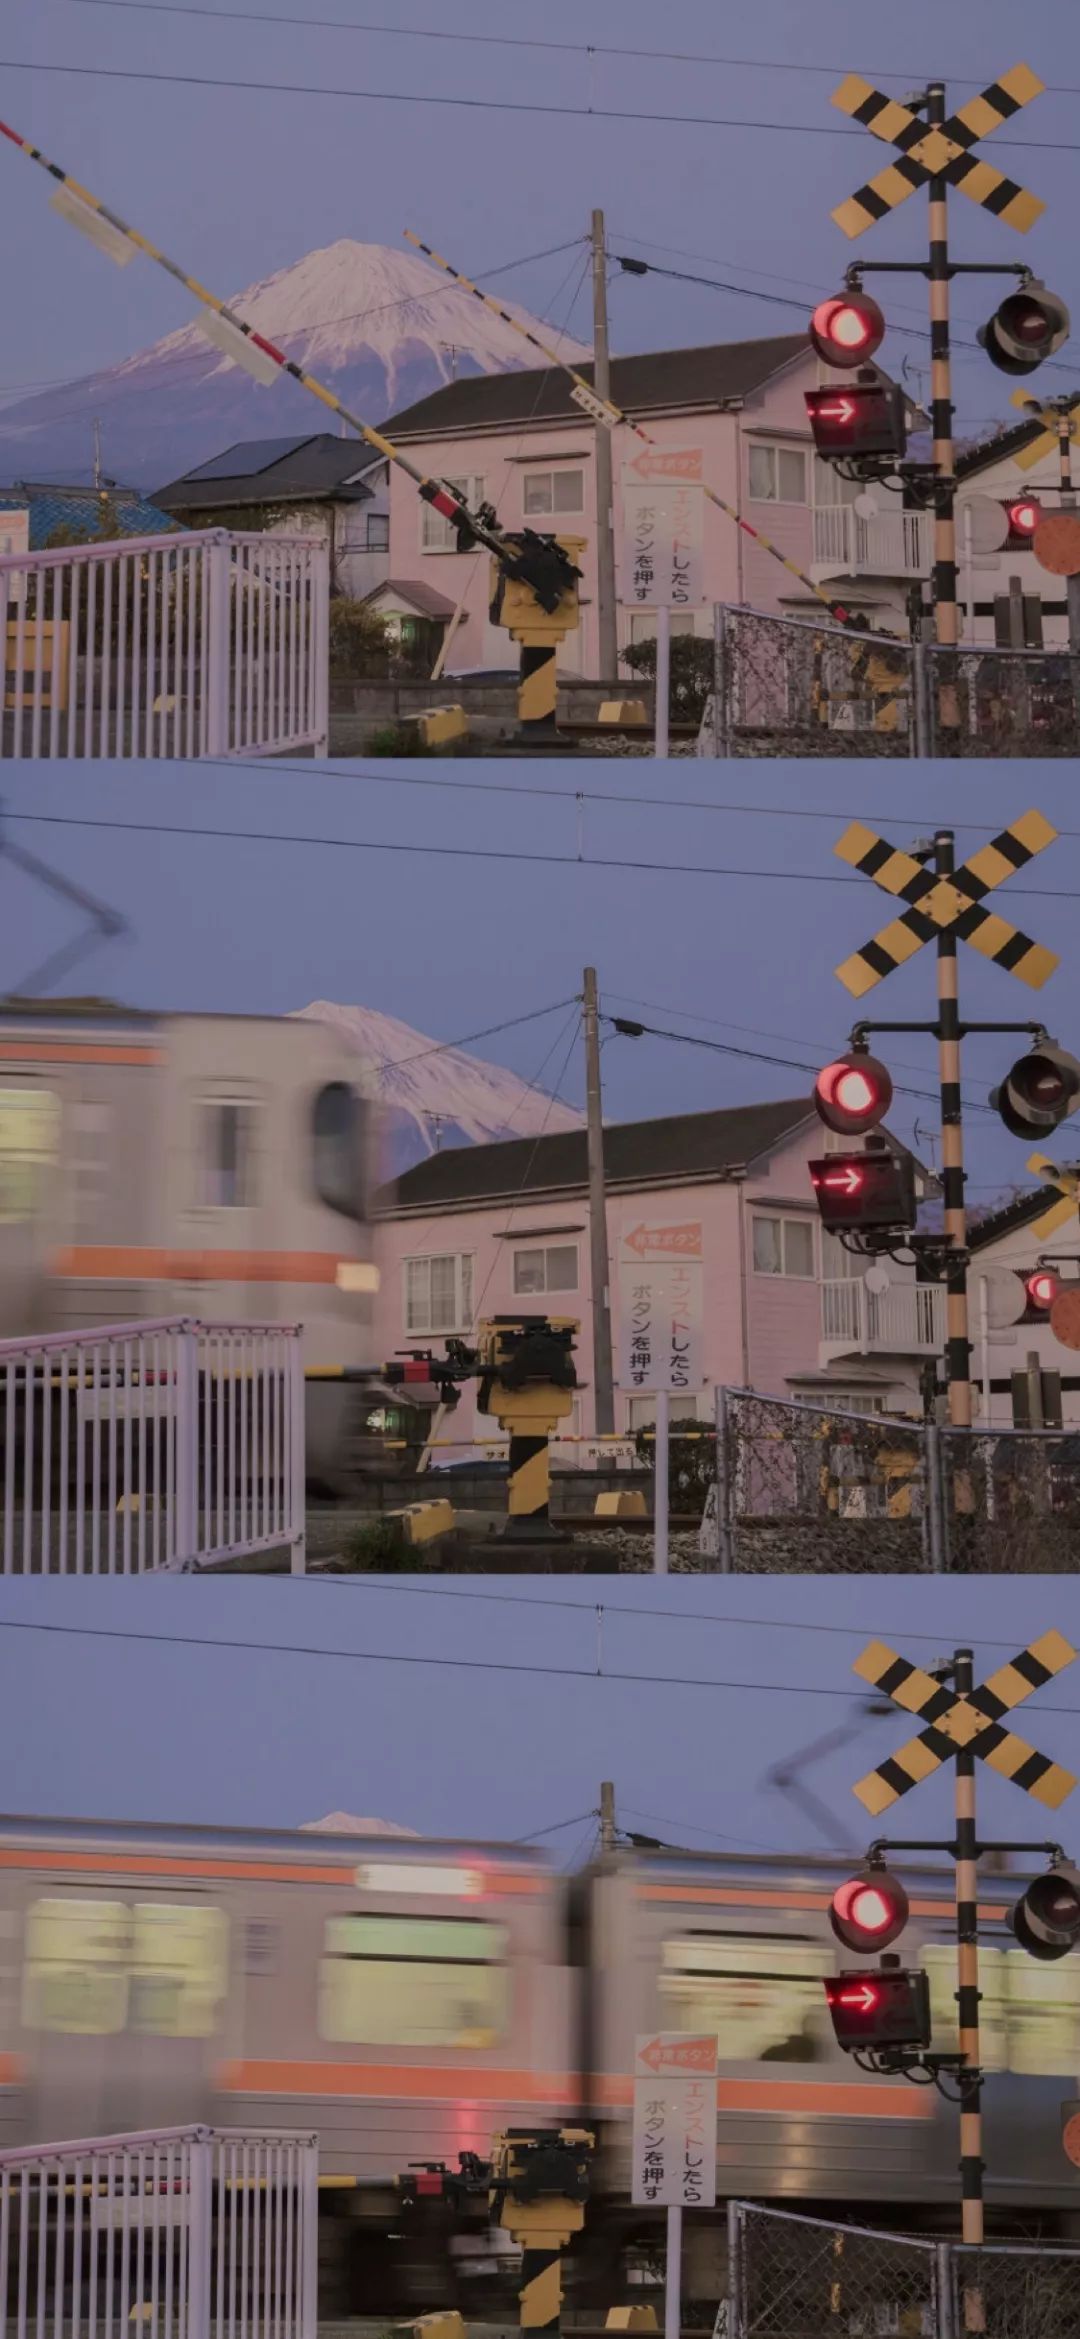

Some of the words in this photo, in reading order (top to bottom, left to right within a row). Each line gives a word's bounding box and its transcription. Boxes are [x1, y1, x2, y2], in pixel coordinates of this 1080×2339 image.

[633, 506, 656, 601] ボタンを押す
[672, 489, 691, 603] エンストしたら
[630, 1285, 652, 1386] ボタンを押す
[669, 1267, 690, 1387] エンストしたら
[642, 2101, 666, 2200] ボタンを押す
[683, 2082, 704, 2202] エンストしたら
